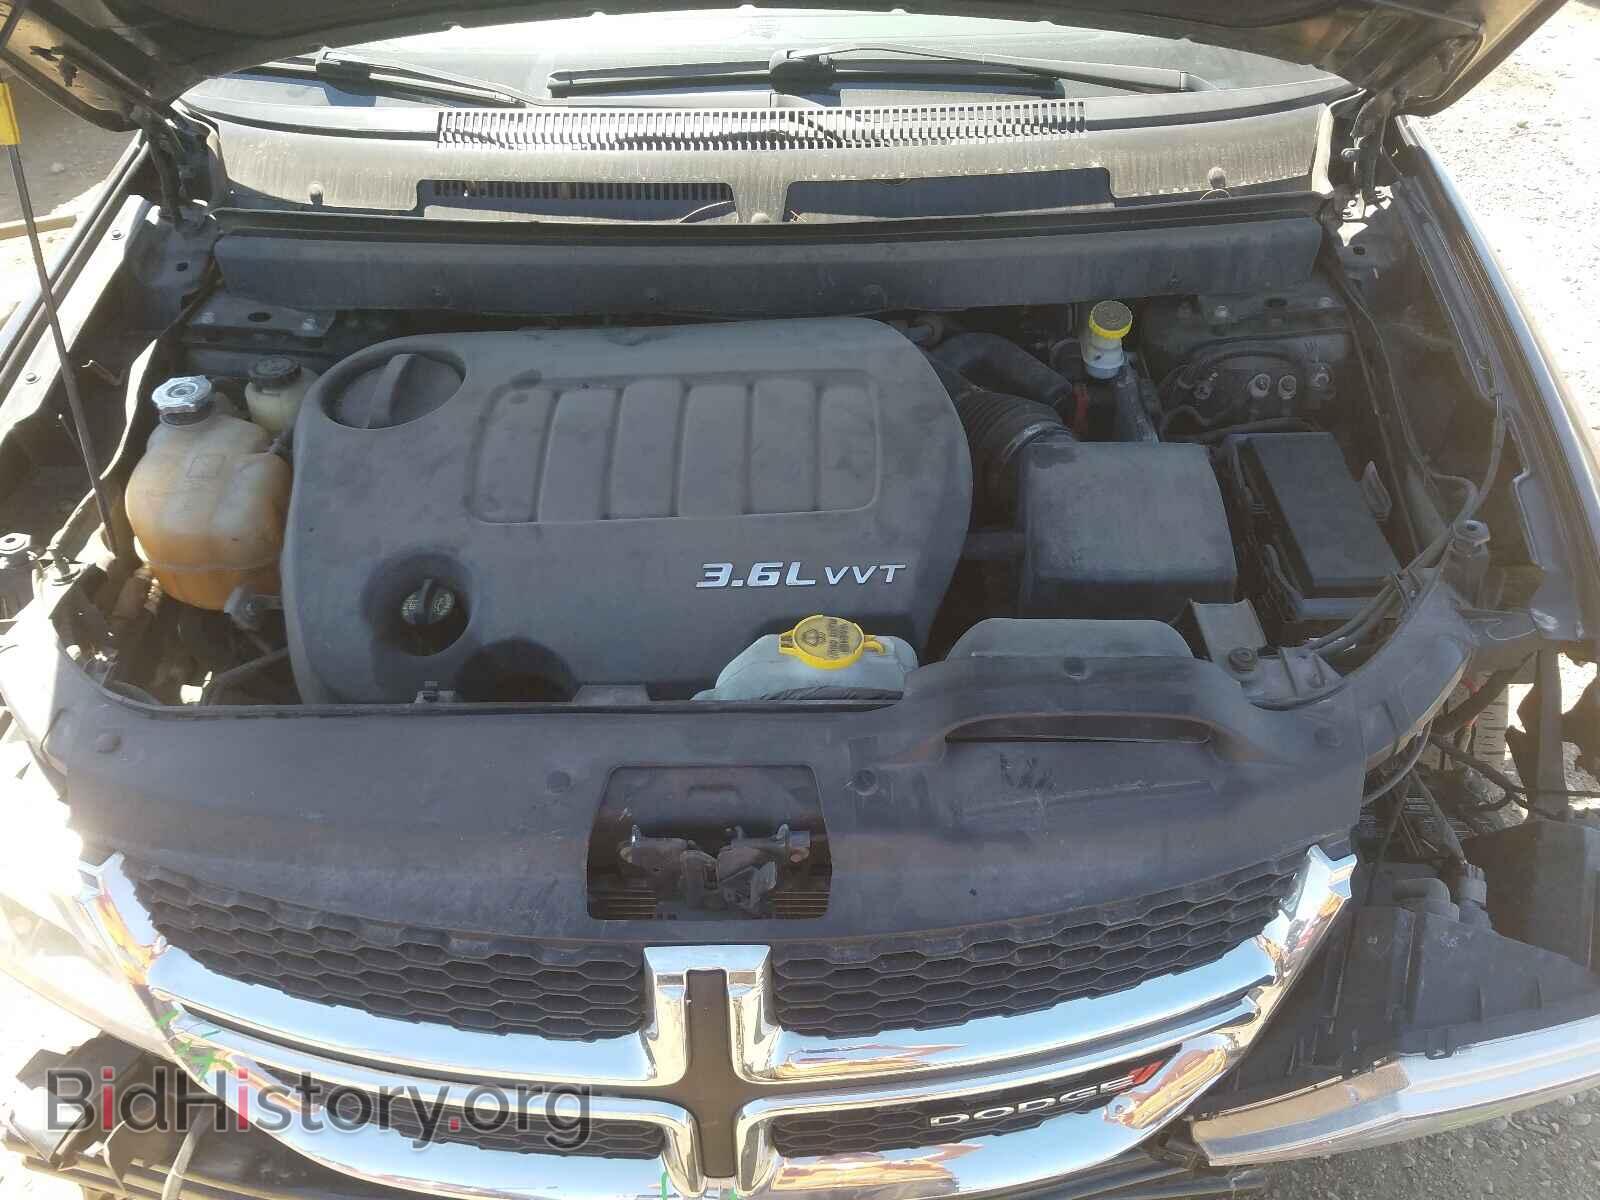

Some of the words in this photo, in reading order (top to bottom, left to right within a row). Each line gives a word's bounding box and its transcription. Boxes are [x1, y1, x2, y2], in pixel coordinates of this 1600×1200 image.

[695, 561, 817, 588] 3.6L
[824, 564, 906, 585] VVT
[929, 1074, 1136, 1127] DODGE
